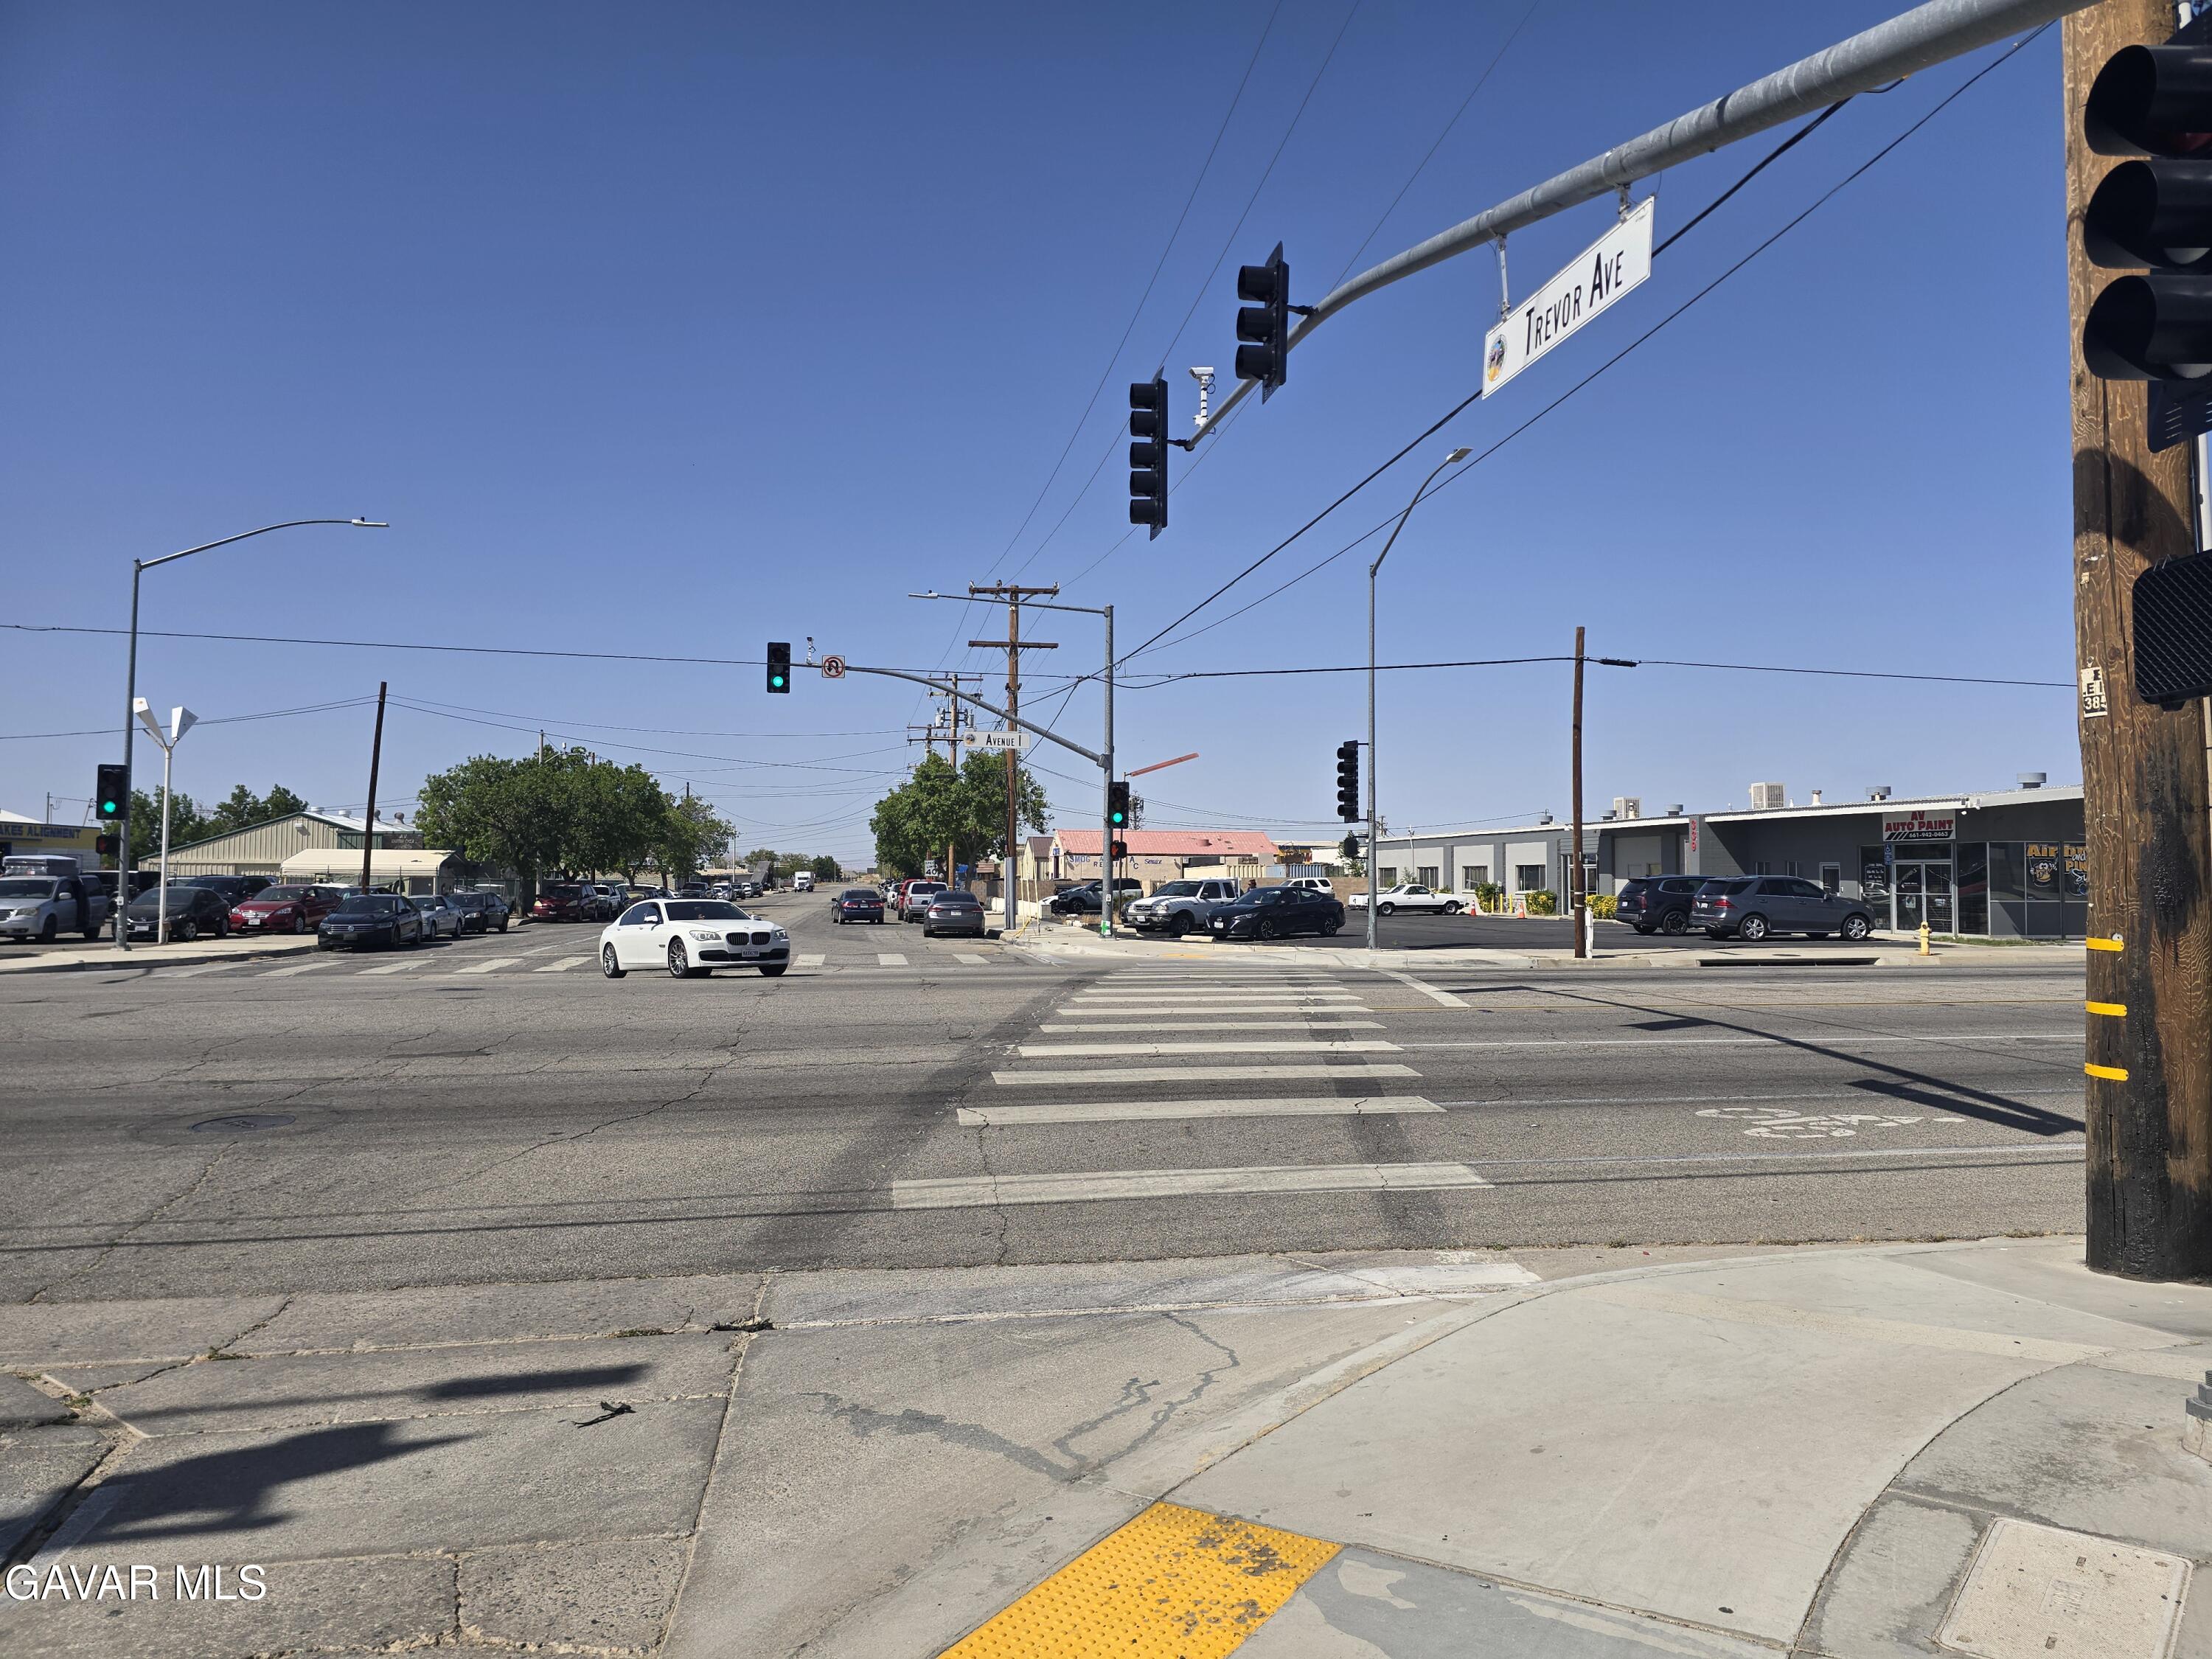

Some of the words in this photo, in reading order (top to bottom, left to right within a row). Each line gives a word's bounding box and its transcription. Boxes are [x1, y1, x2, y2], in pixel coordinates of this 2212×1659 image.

[1526, 285, 1582, 355] TREVOR
[1589, 250, 1624, 308] AVE
[986, 734, 1015, 746] AVENUE
[1018, 735, 1021, 746] I
[1910, 810, 1925, 821] AV
[1885, 821, 1915, 832] AUTO
[1918, 819, 1954, 830] PAINT
[27, 826, 81, 838] ALIGNMENT
[2026, 843, 2059, 858] Air
